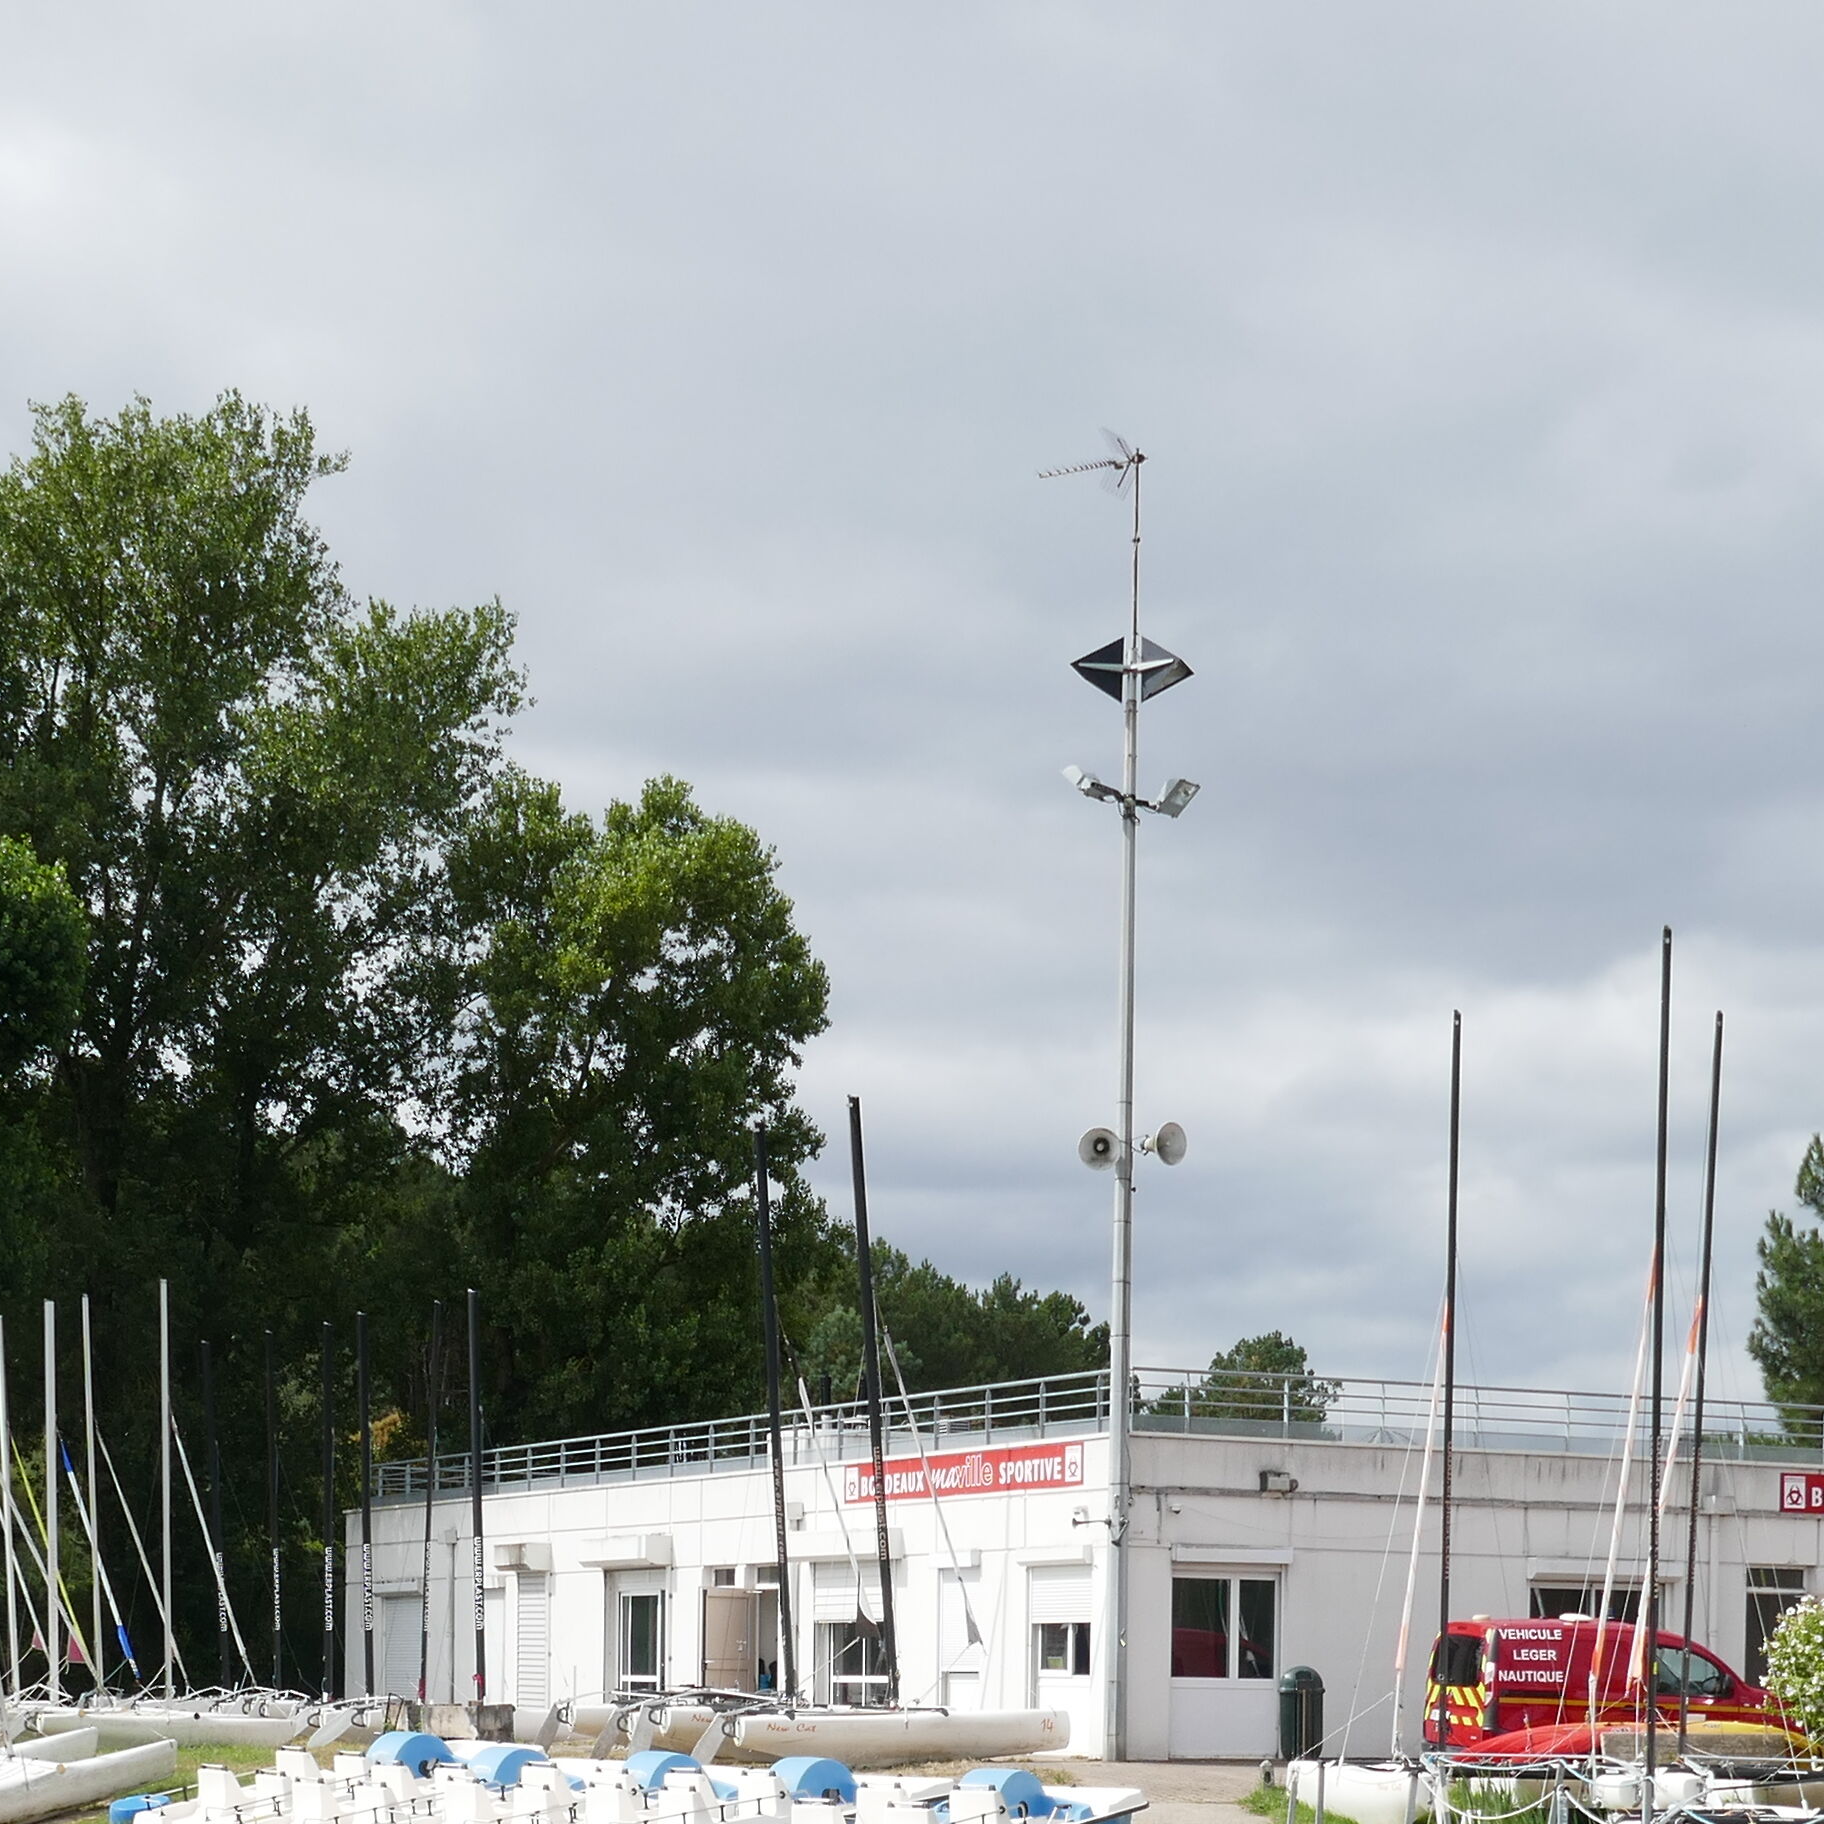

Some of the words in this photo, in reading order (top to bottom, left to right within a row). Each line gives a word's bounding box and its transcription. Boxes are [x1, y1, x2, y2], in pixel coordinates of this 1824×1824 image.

[861, 1470, 924, 1496] BODEAUX
[999, 1456, 1062, 1484] SPORTIVE
[1498, 1628, 1562, 1640] VEHICULE
[1513, 1649, 1557, 1661] LEGER
[1498, 1670, 1564, 1683] NAUTIQUE
[766, 1723, 789, 1732] New
[796, 1723, 816, 1732] Cat
